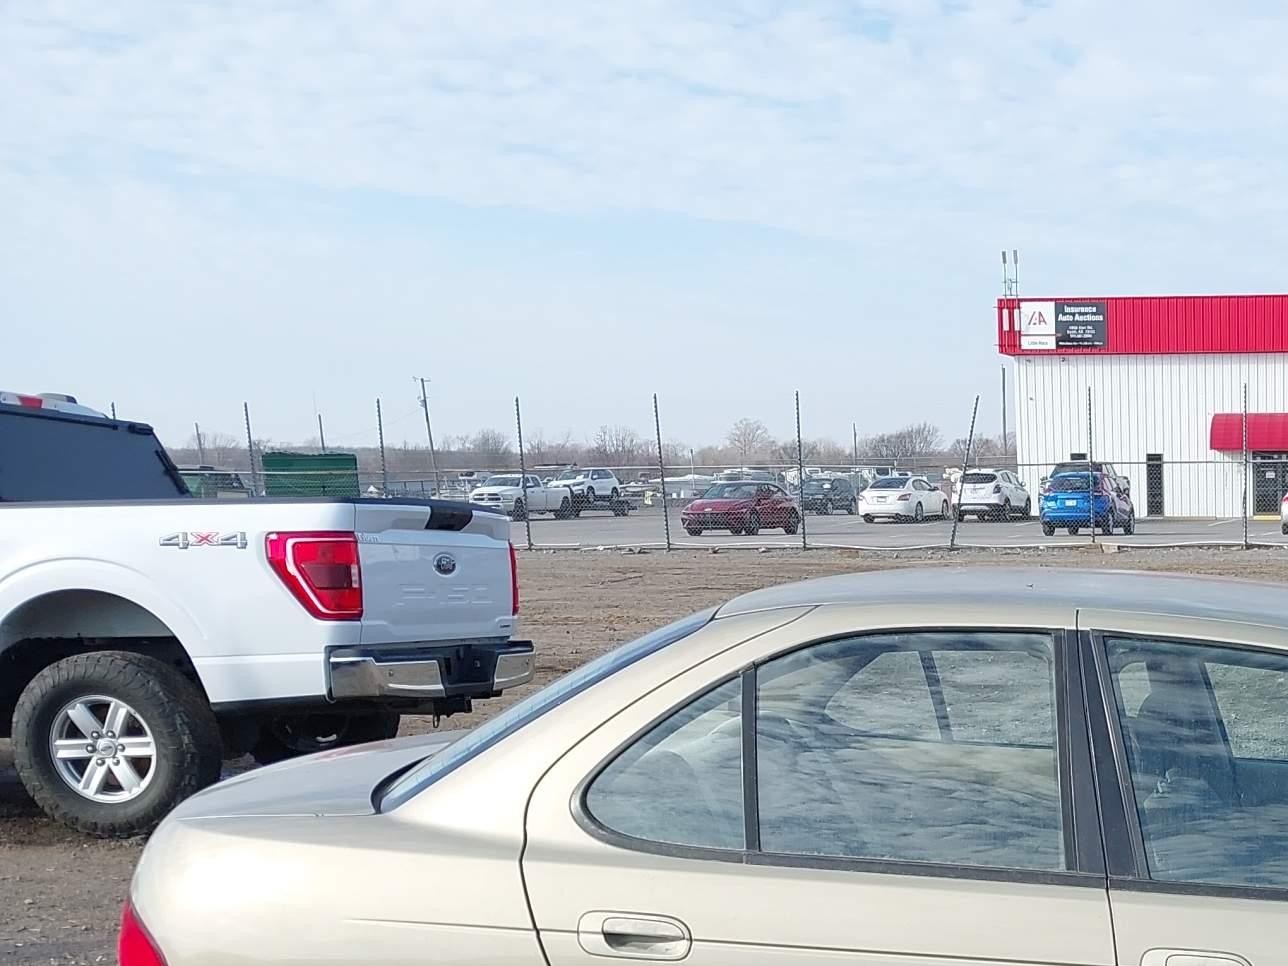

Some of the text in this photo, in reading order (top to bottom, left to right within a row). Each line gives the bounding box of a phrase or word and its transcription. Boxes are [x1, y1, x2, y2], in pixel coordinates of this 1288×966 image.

[1064, 305, 1097, 313] Insurance
[1058, 313, 1103, 321] Auto Auctions
